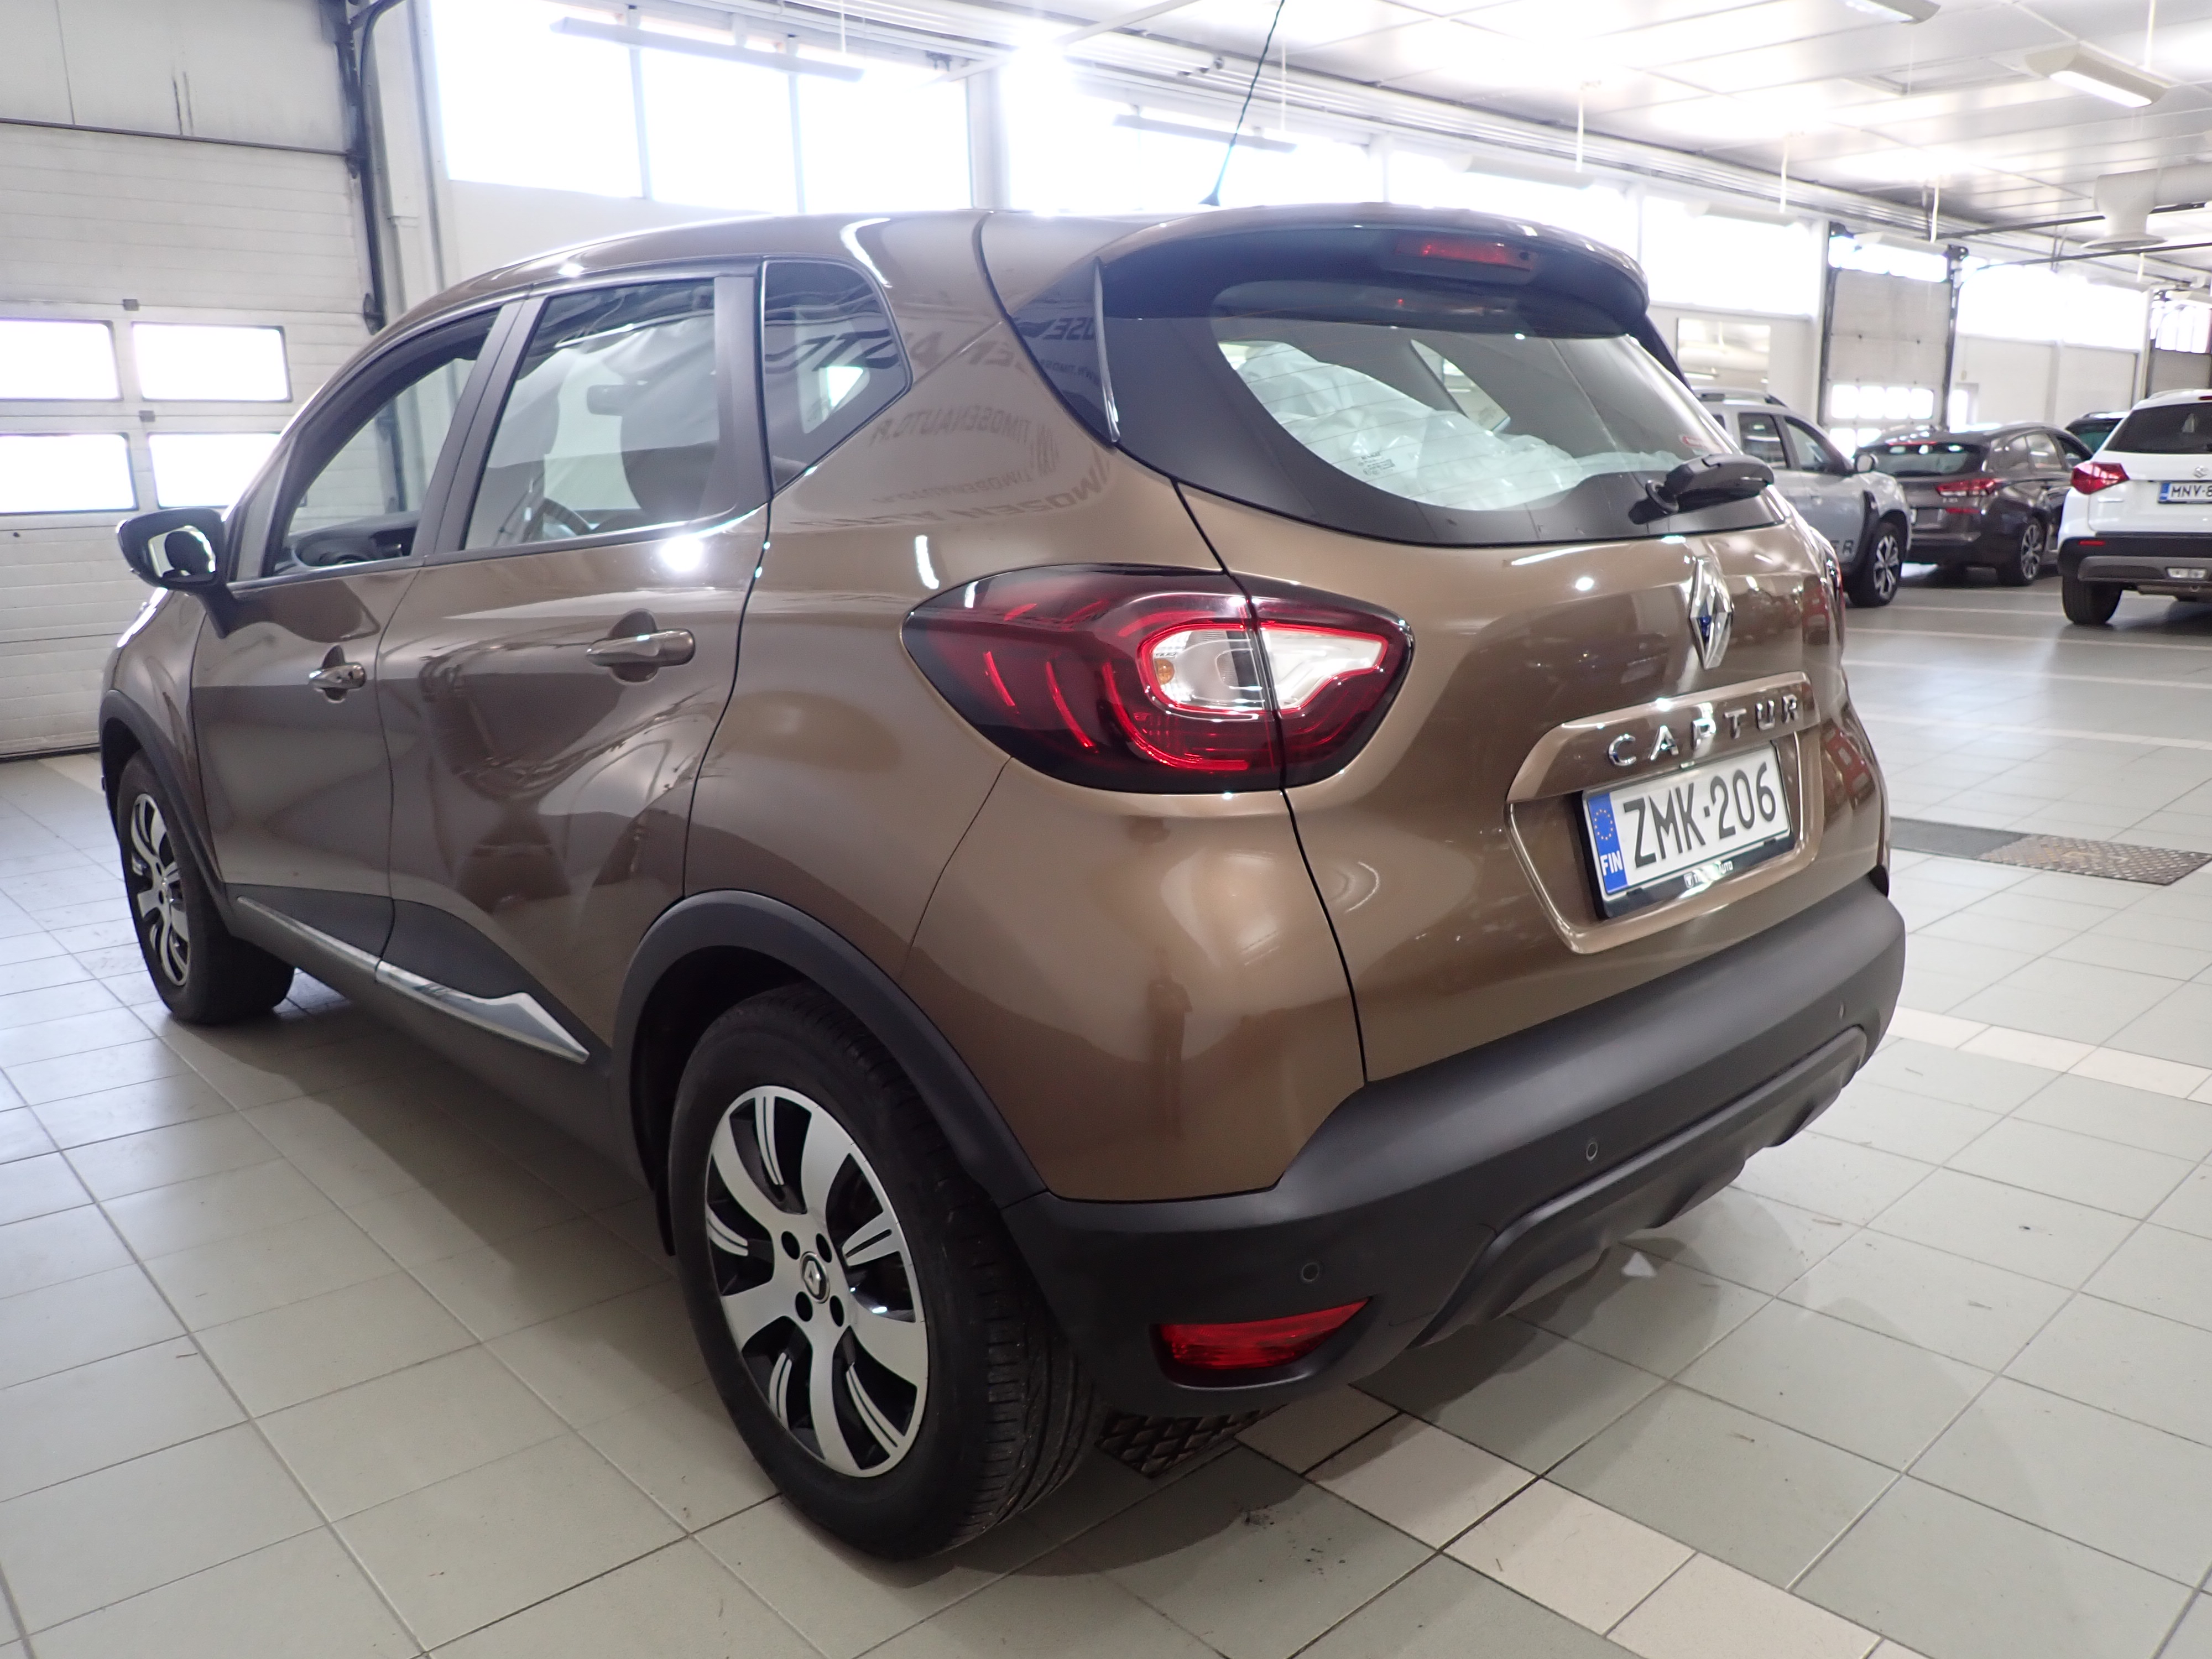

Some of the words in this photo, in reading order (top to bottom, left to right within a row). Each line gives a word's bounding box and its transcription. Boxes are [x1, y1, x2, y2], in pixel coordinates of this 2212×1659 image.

[1608, 693, 1798, 767] CAPTUR
[1623, 761, 1776, 869] ZMK-206
[1600, 851, 1623, 876] FIN
